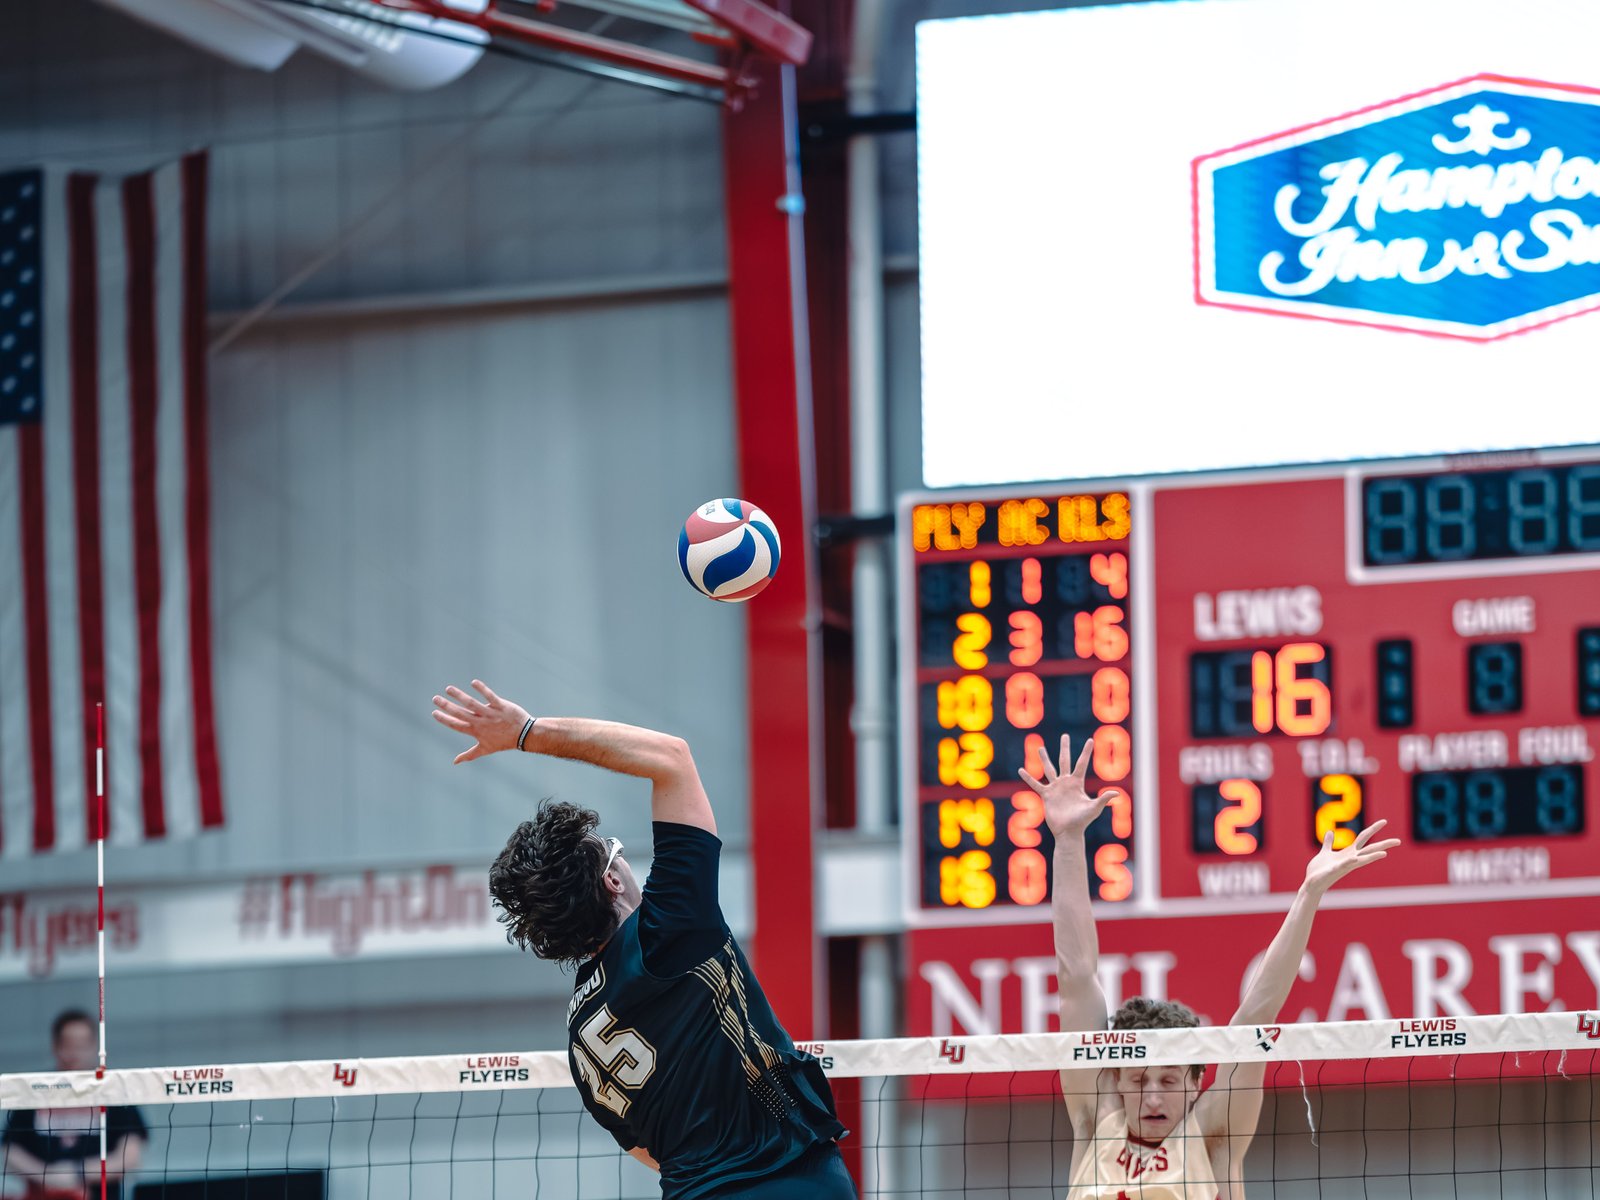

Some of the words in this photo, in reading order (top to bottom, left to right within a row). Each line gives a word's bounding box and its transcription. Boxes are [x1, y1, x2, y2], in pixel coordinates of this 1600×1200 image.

[1194, 585, 1323, 641] LEWIS
[1453, 597, 1535, 636] GAME
[953, 612, 992, 670] 2
[1008, 610, 1043, 667] 3
[1074, 605, 1129, 662] 16
[1005, 672, 1044, 729] 0
[1092, 667, 1130, 724] 0
[1252, 642, 1331, 736] 16
[1093, 725, 1131, 782] 0
[1180, 744, 1273, 783] FOULS
[1399, 731, 1508, 771] PLAYER
[1518, 727, 1594, 764] FOUL
[1214, 778, 1262, 855] 2
[1315, 774, 1362, 850] 2
[1008, 848, 1047, 906] 0
[1448, 848, 1551, 883] MATCH
[1081, 1033, 1137, 1045] LEWIS
[1391, 1033, 1467, 1048] FLYERS
[1400, 1019, 1457, 1033] LEWIS
[467, 1056, 520, 1069] LEWIS
[572, 1003, 657, 1119] 25
[797, 1044, 825, 1056] WIS
[939, 1039, 966, 1065] LU
[1073, 1046, 1147, 1061] FLYERS
[165, 1081, 234, 1096] FLYERS
[173, 1068, 224, 1081] LEWIS
[333, 1063, 357, 1087] LU
[459, 1069, 529, 1084] FLYERS
